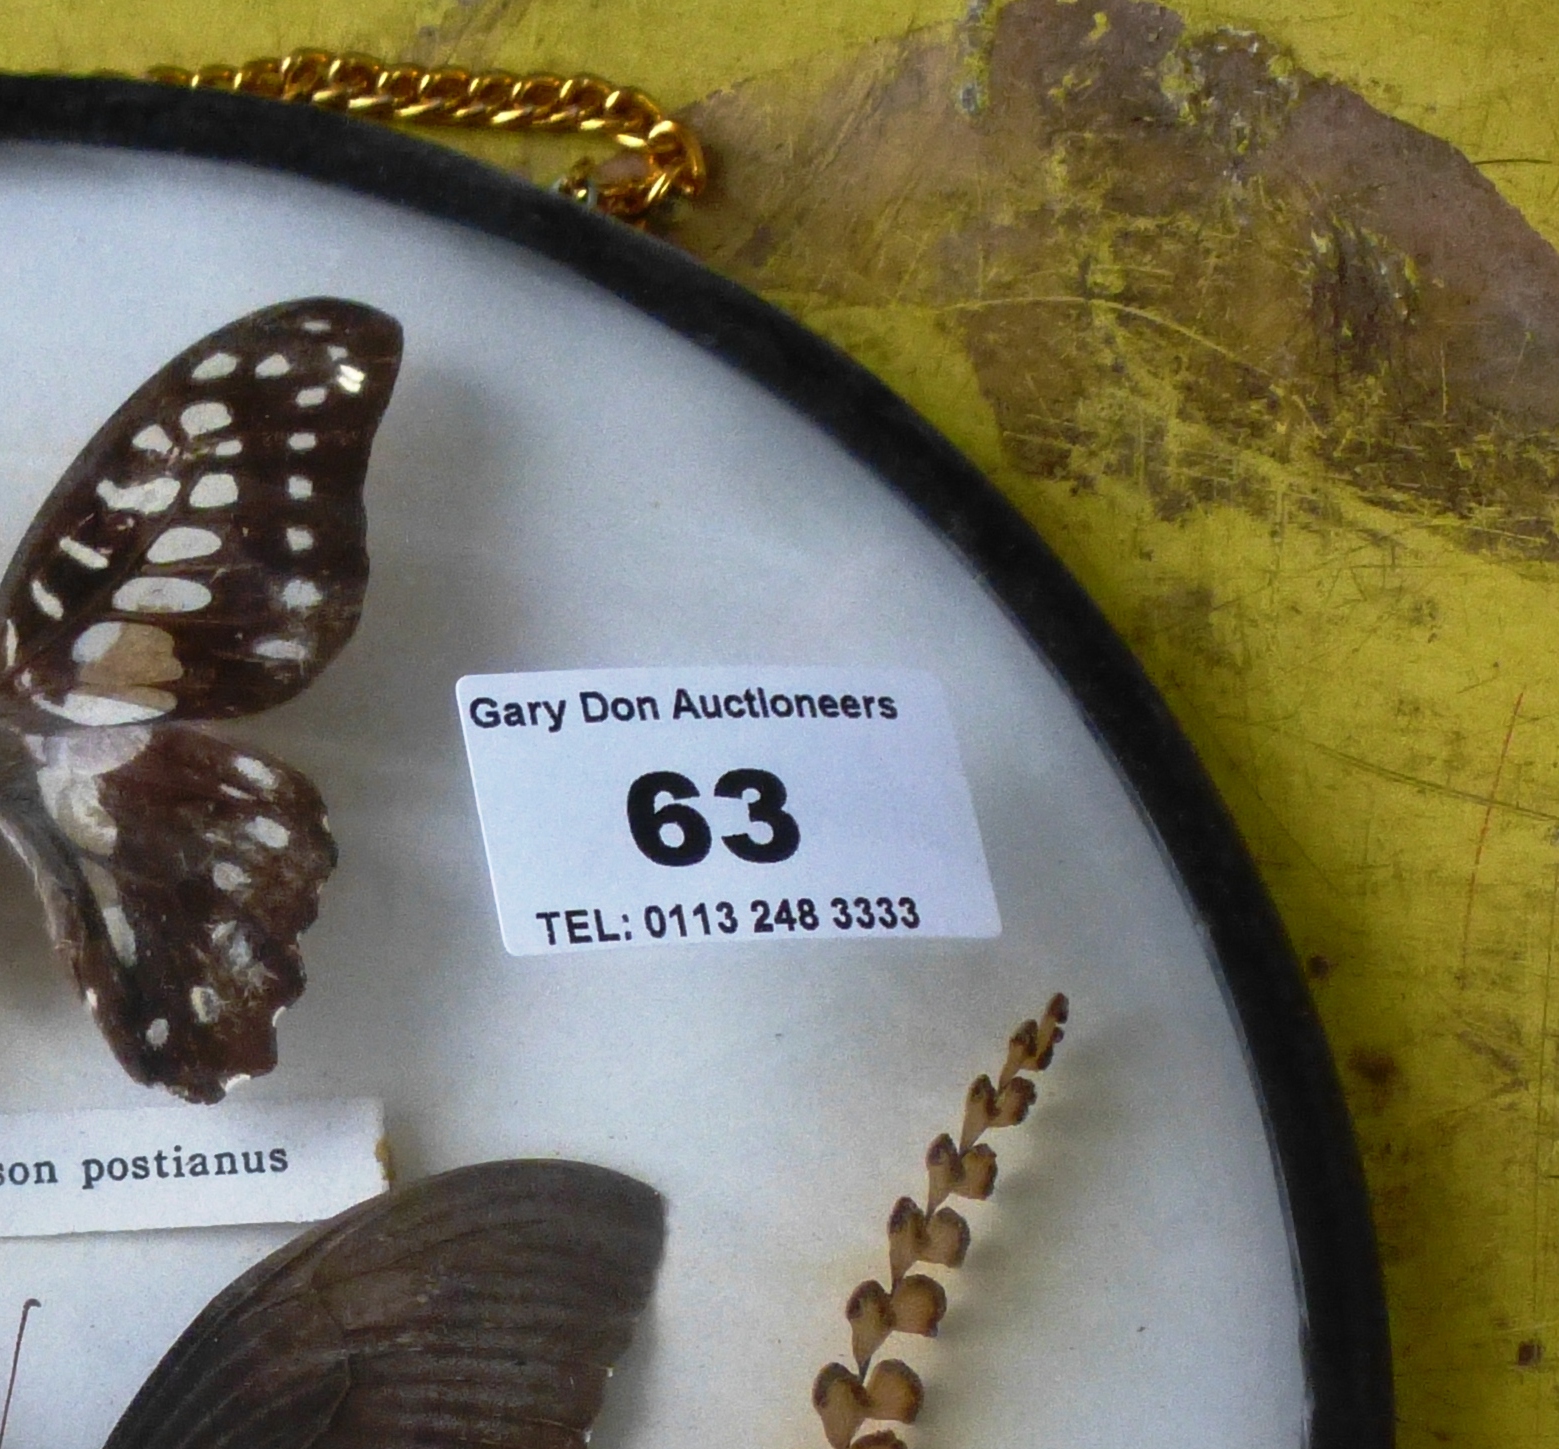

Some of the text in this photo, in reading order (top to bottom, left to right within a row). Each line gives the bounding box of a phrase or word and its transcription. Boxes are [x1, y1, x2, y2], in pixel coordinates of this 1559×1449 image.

[469, 687, 899, 733] Gary Don Auctioneers
[626, 768, 801, 867] 63
[536, 896, 920, 946] TEL: 0113 248 3333
[81, 1144, 289, 1189] postianus
